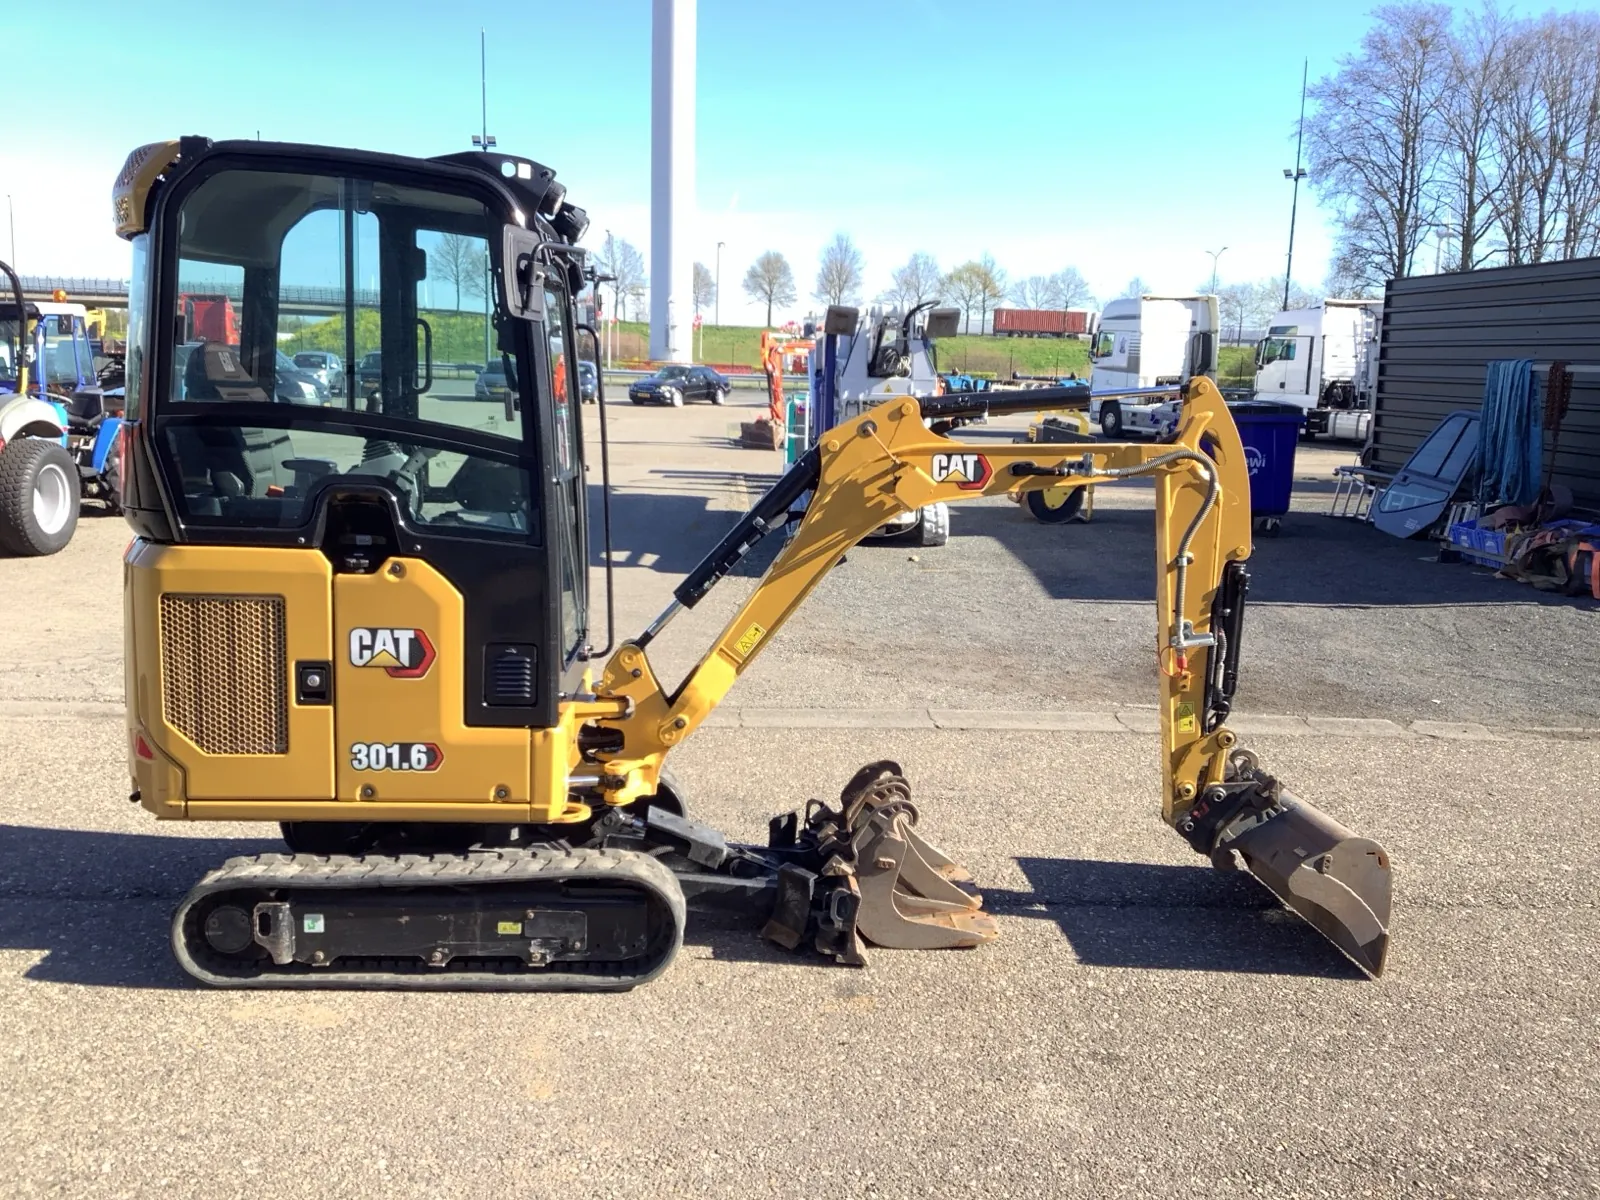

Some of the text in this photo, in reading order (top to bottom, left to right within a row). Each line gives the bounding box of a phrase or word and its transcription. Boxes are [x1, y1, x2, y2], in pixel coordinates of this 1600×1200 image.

[933, 454, 978, 482] CAT
[350, 628, 415, 667] CAT
[351, 743, 427, 770] 301.6
